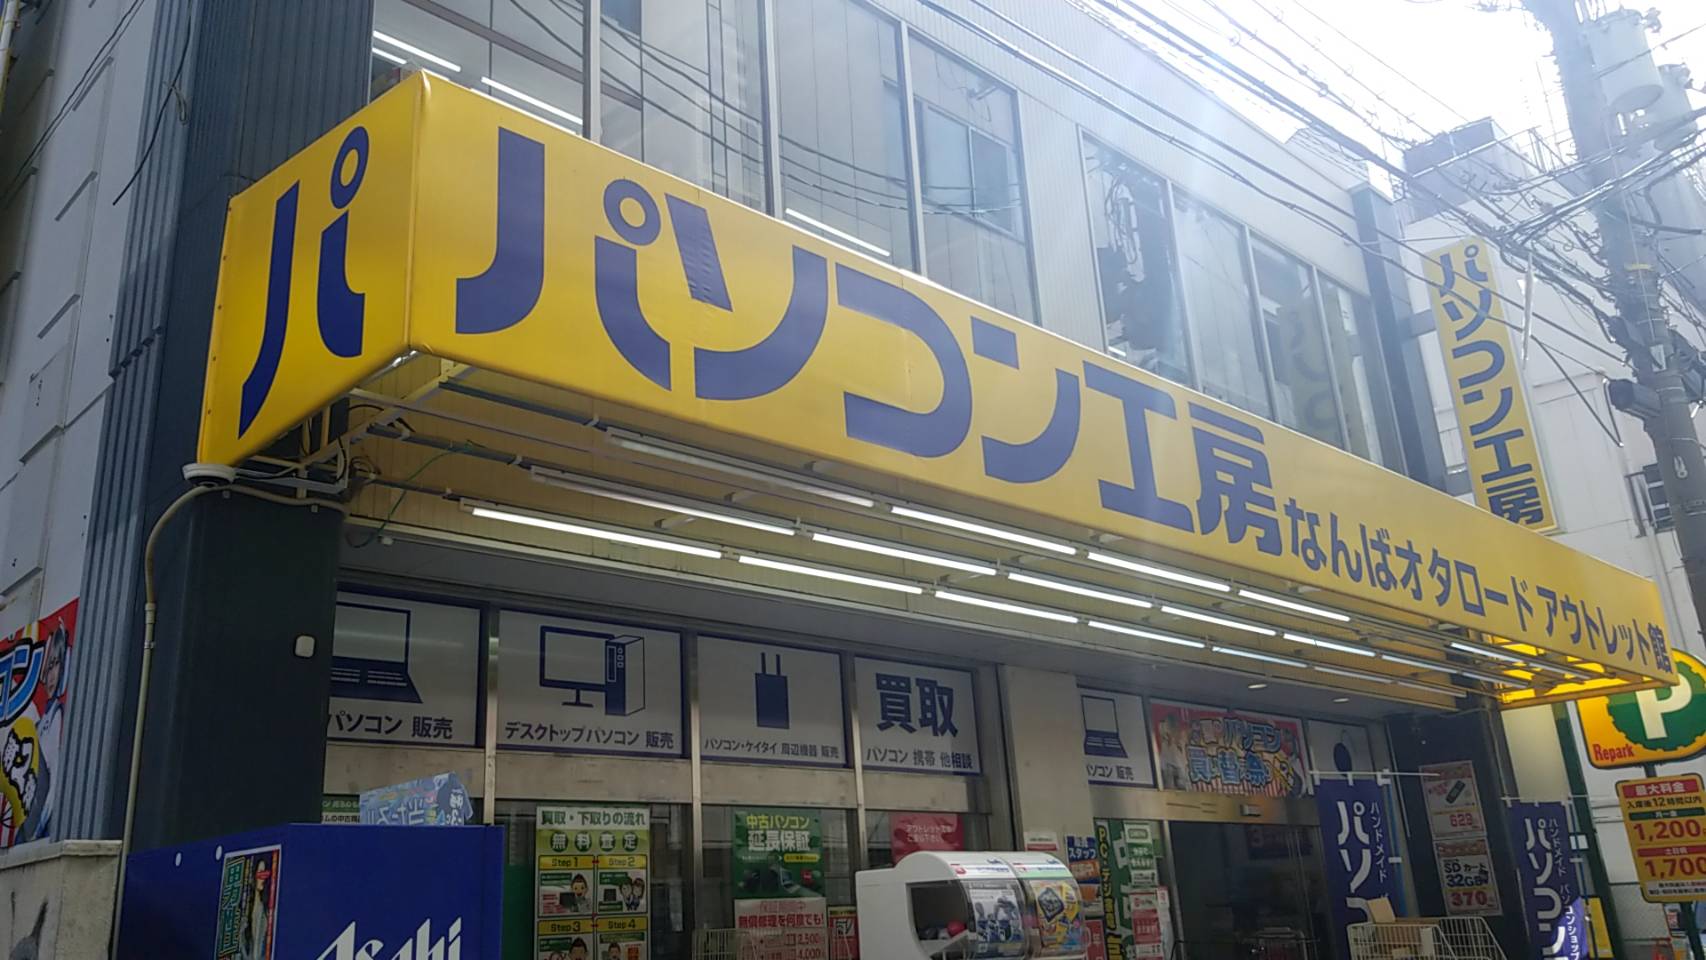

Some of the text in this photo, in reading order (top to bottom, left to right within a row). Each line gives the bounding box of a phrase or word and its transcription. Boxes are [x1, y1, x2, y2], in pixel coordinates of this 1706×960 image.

[238, 125, 370, 440] パ
[1438, 244, 1545, 524] パソコン工房
[456, 126, 1673, 675] パソコン工房 なんばオタロード アウトレット館
[875, 672, 958, 738] 買取
[326, 710, 453, 740] パソコン 販売
[504, 720, 674, 749] デスクトップパソコン 販売
[820, 744, 839, 759] 販売
[866, 745, 909, 764] パソコン
[1592, 743, 1634, 762] Repark
[1635, 782, 1686, 797] 最大料金
[747, 814, 810, 829] 中古パソコン
[1633, 818, 1706, 842] 1,200
[747, 830, 811, 852] 延長保証
[1068, 847, 1097, 860] スタッフ
[1370, 801, 1388, 884] ハンドメイド
[1548, 818, 1567, 877] ハンドメイド
[1524, 818, 1568, 960] パソコン
